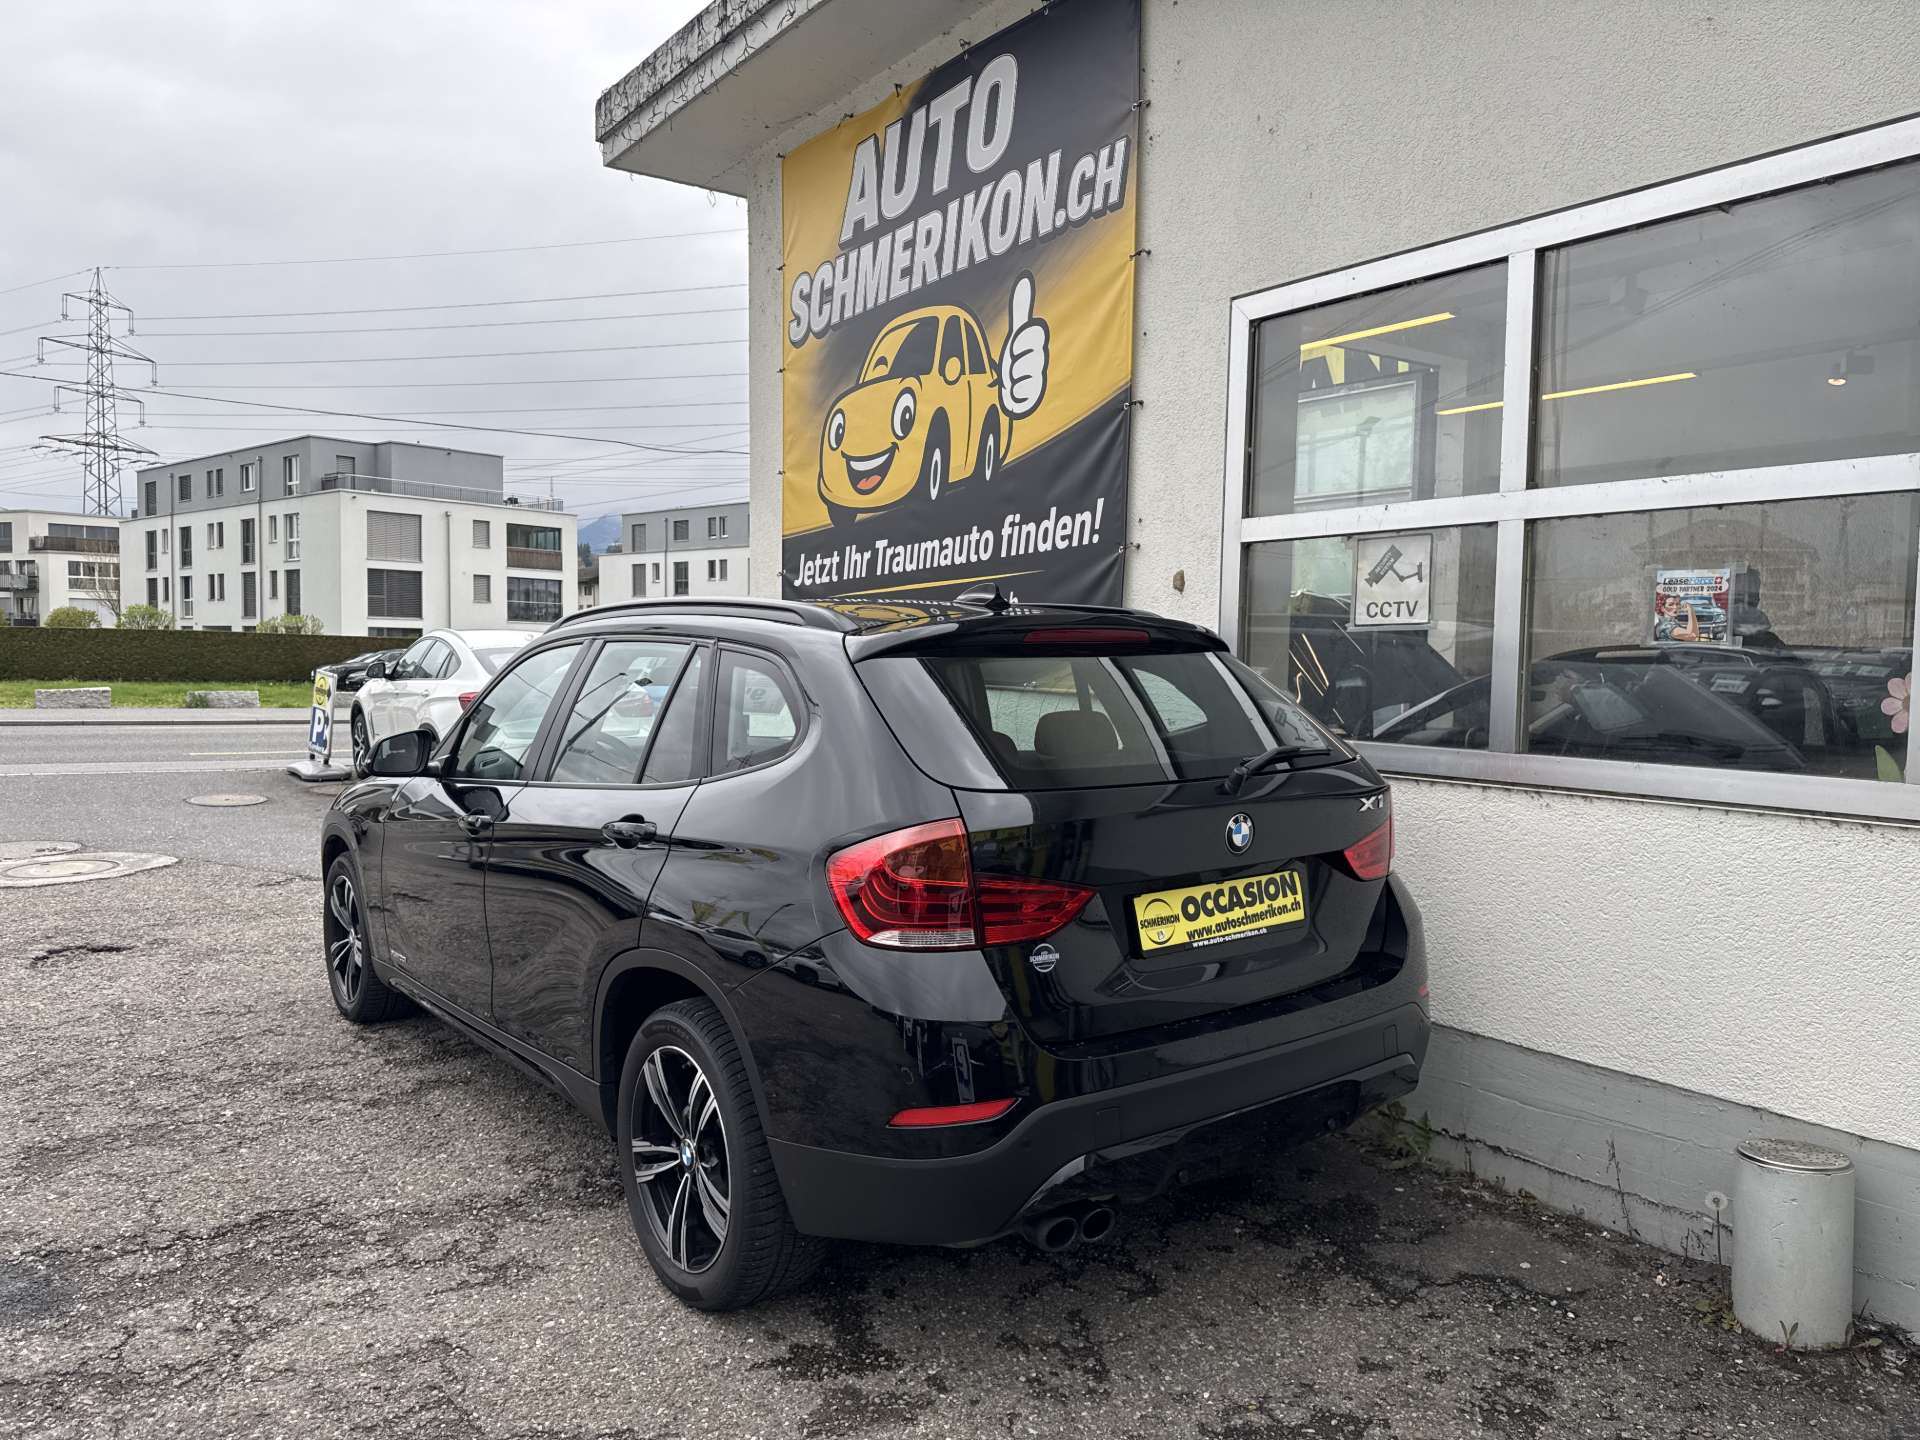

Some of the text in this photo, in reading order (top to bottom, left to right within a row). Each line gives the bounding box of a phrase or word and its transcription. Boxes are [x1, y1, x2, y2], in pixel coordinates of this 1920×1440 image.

[839, 53, 1018, 246] AUTO
[788, 137, 1128, 342] SCHMERIKON.CH
[793, 498, 1105, 588] Jetzt Ihr Traumauto finden!
[1366, 600, 1419, 619] CCTV
[1359, 794, 1384, 812] X1
[1181, 871, 1299, 922] OCCASION
[1186, 898, 1302, 941] www.autoschmerikon.ch
[1139, 913, 1181, 930] SCHMERIKON
